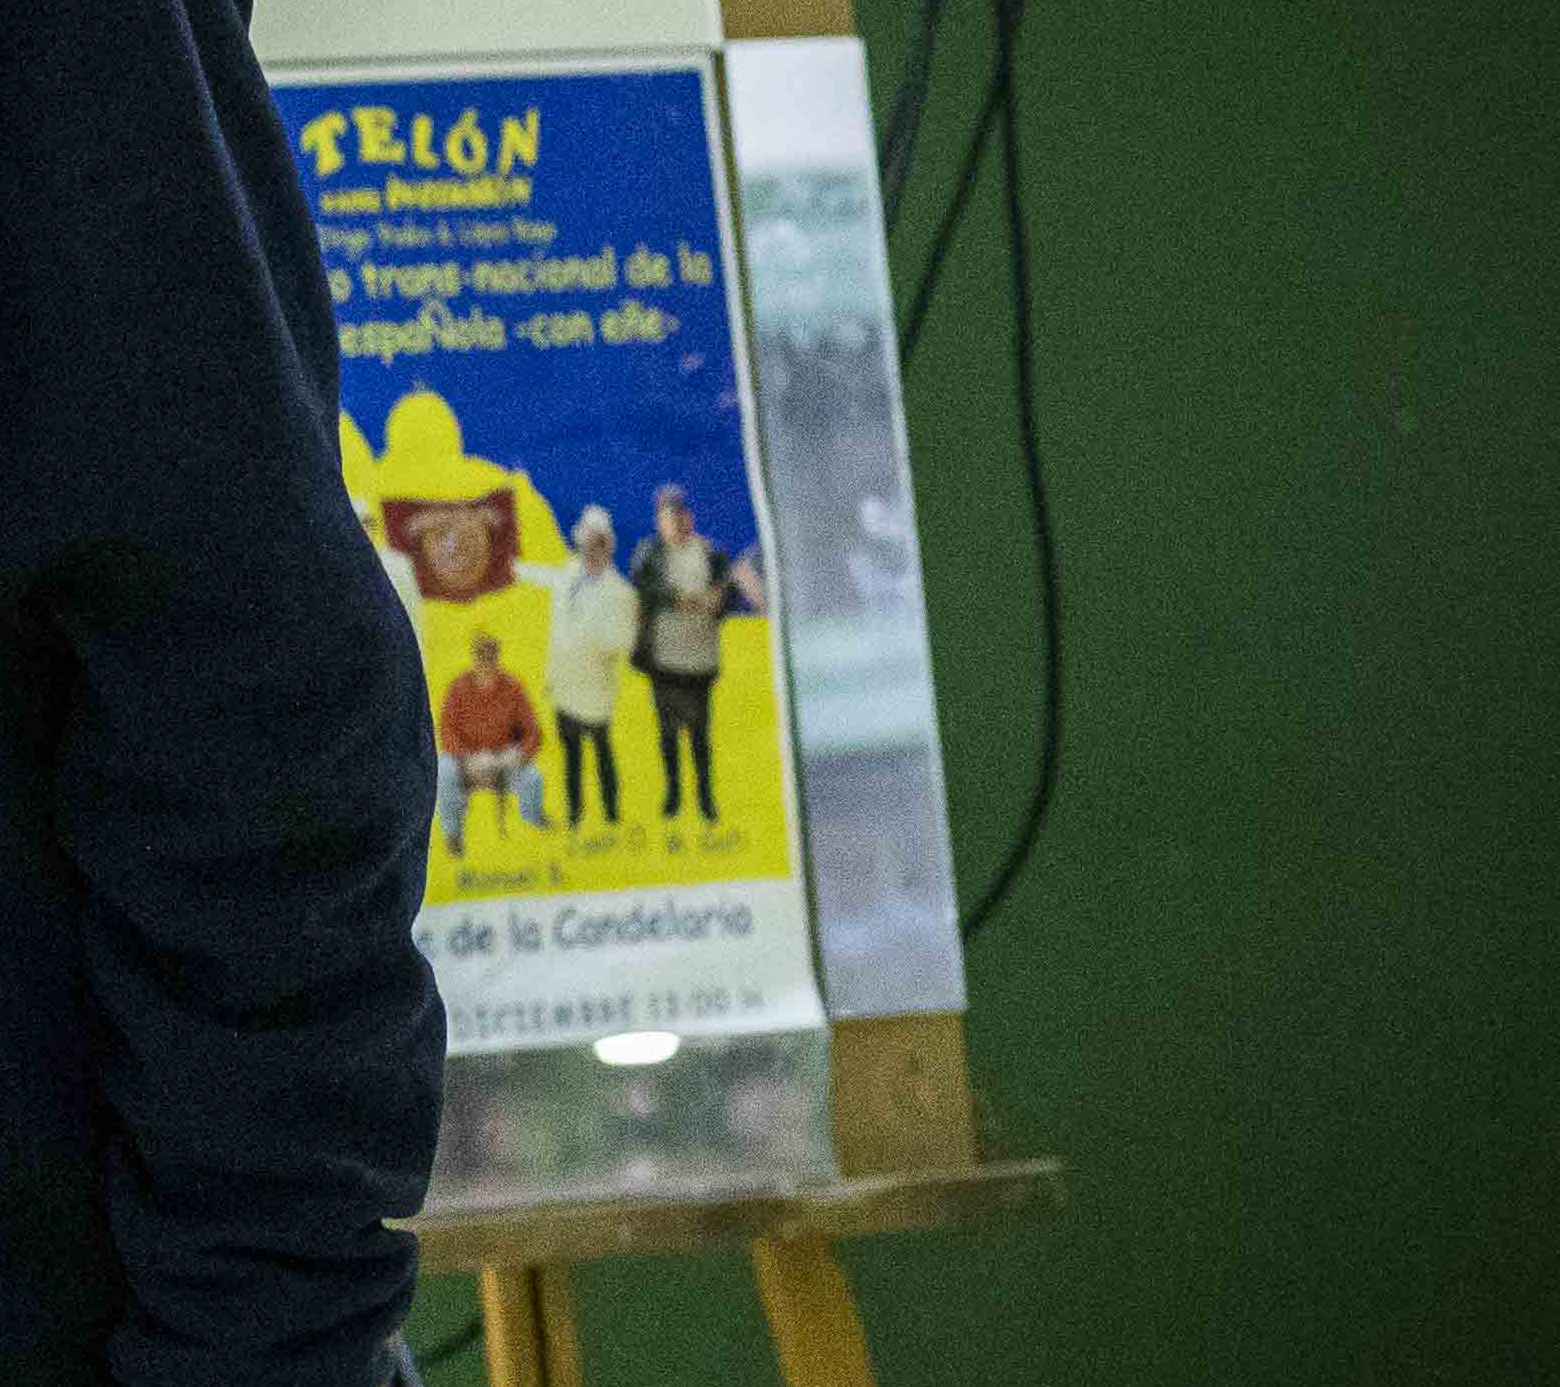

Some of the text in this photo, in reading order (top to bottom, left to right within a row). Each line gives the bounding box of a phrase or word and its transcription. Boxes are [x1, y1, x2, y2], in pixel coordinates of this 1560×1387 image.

[301, 107, 540, 176] TELÓN
[625, 243, 670, 288] de
[678, 240, 712, 285] la
[446, 916, 494, 956] de
[508, 907, 541, 952] la
[554, 900, 753, 949] Candelaria
